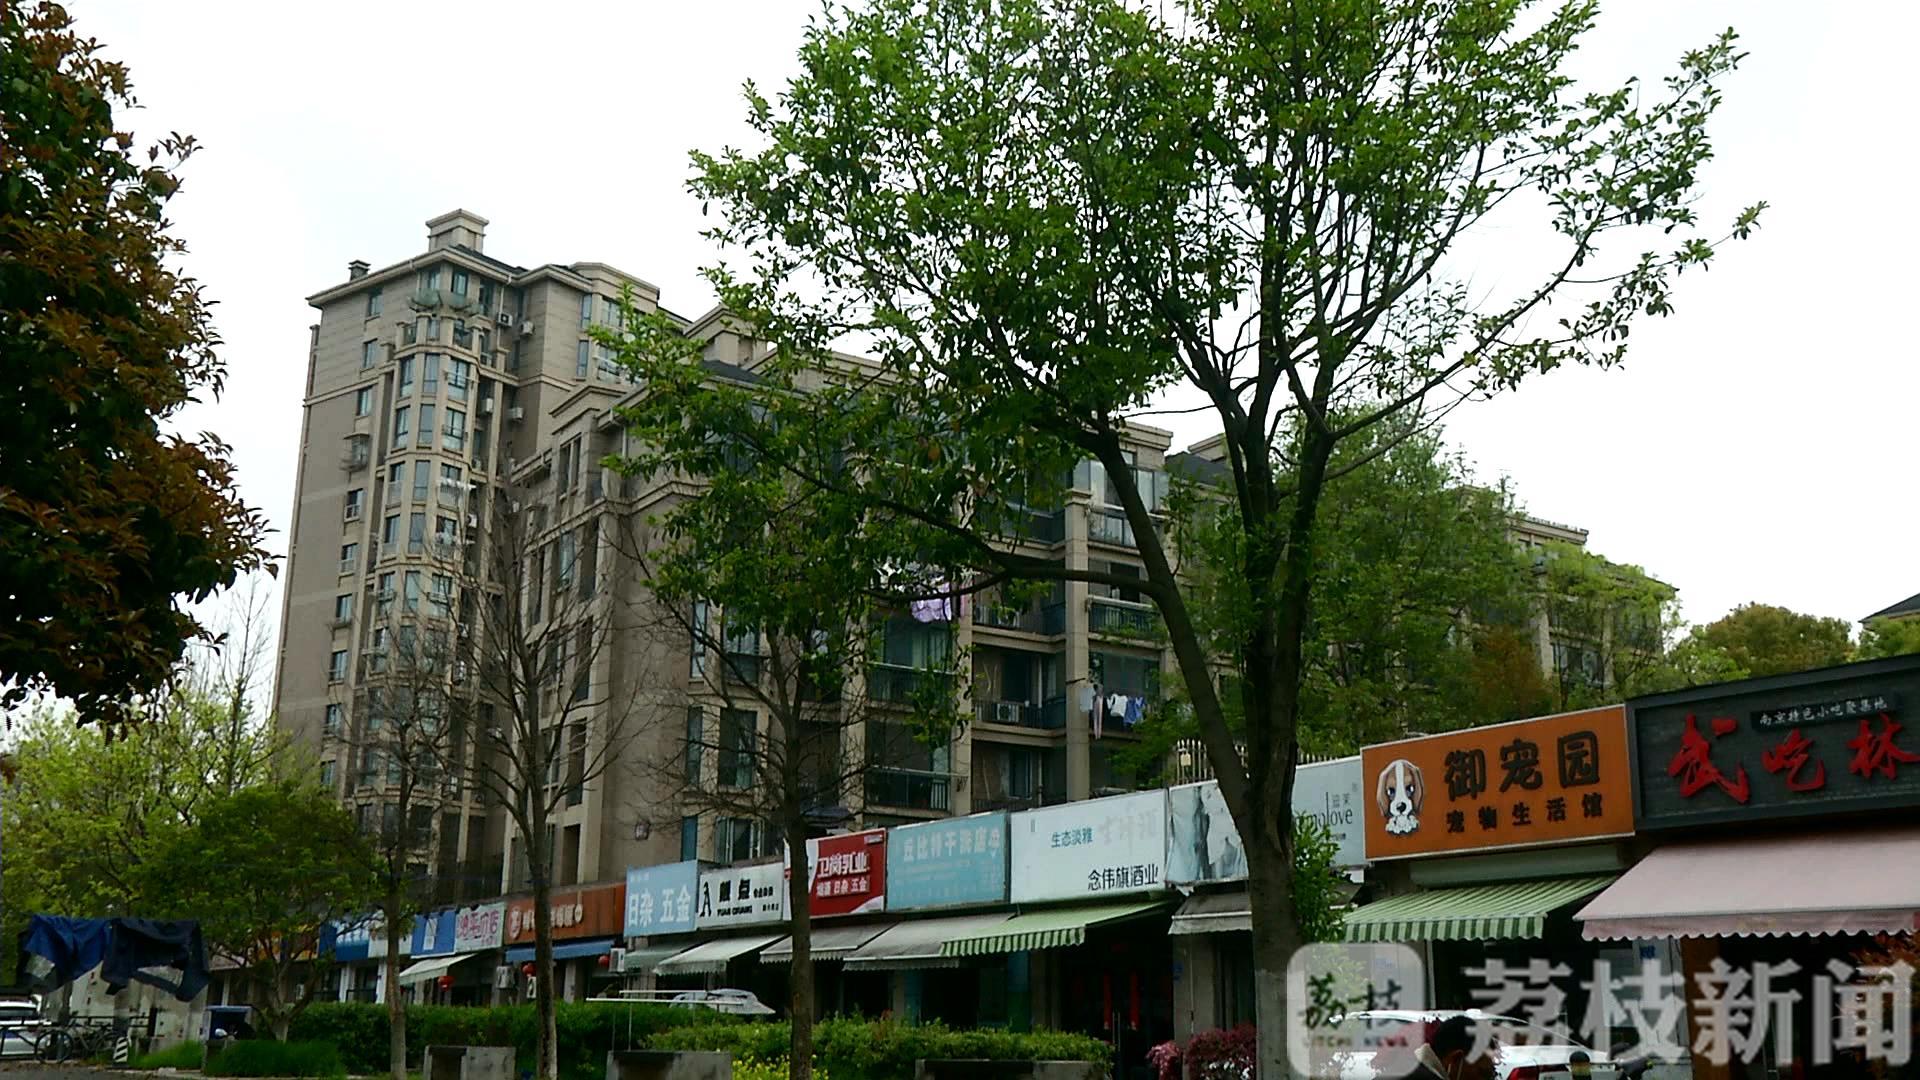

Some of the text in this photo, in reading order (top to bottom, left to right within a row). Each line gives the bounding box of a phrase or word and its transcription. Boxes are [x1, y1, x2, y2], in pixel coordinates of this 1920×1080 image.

[1444, 731, 1600, 802] 御宠园
[1446, 793, 1603, 834] 宠物生活馆
[1051, 827, 1093, 848] 生态淡雅
[1088, 863, 1158, 891] 念伟旗酒业
[628, 888, 653, 928] 日杂
[660, 884, 691, 923] 五金
